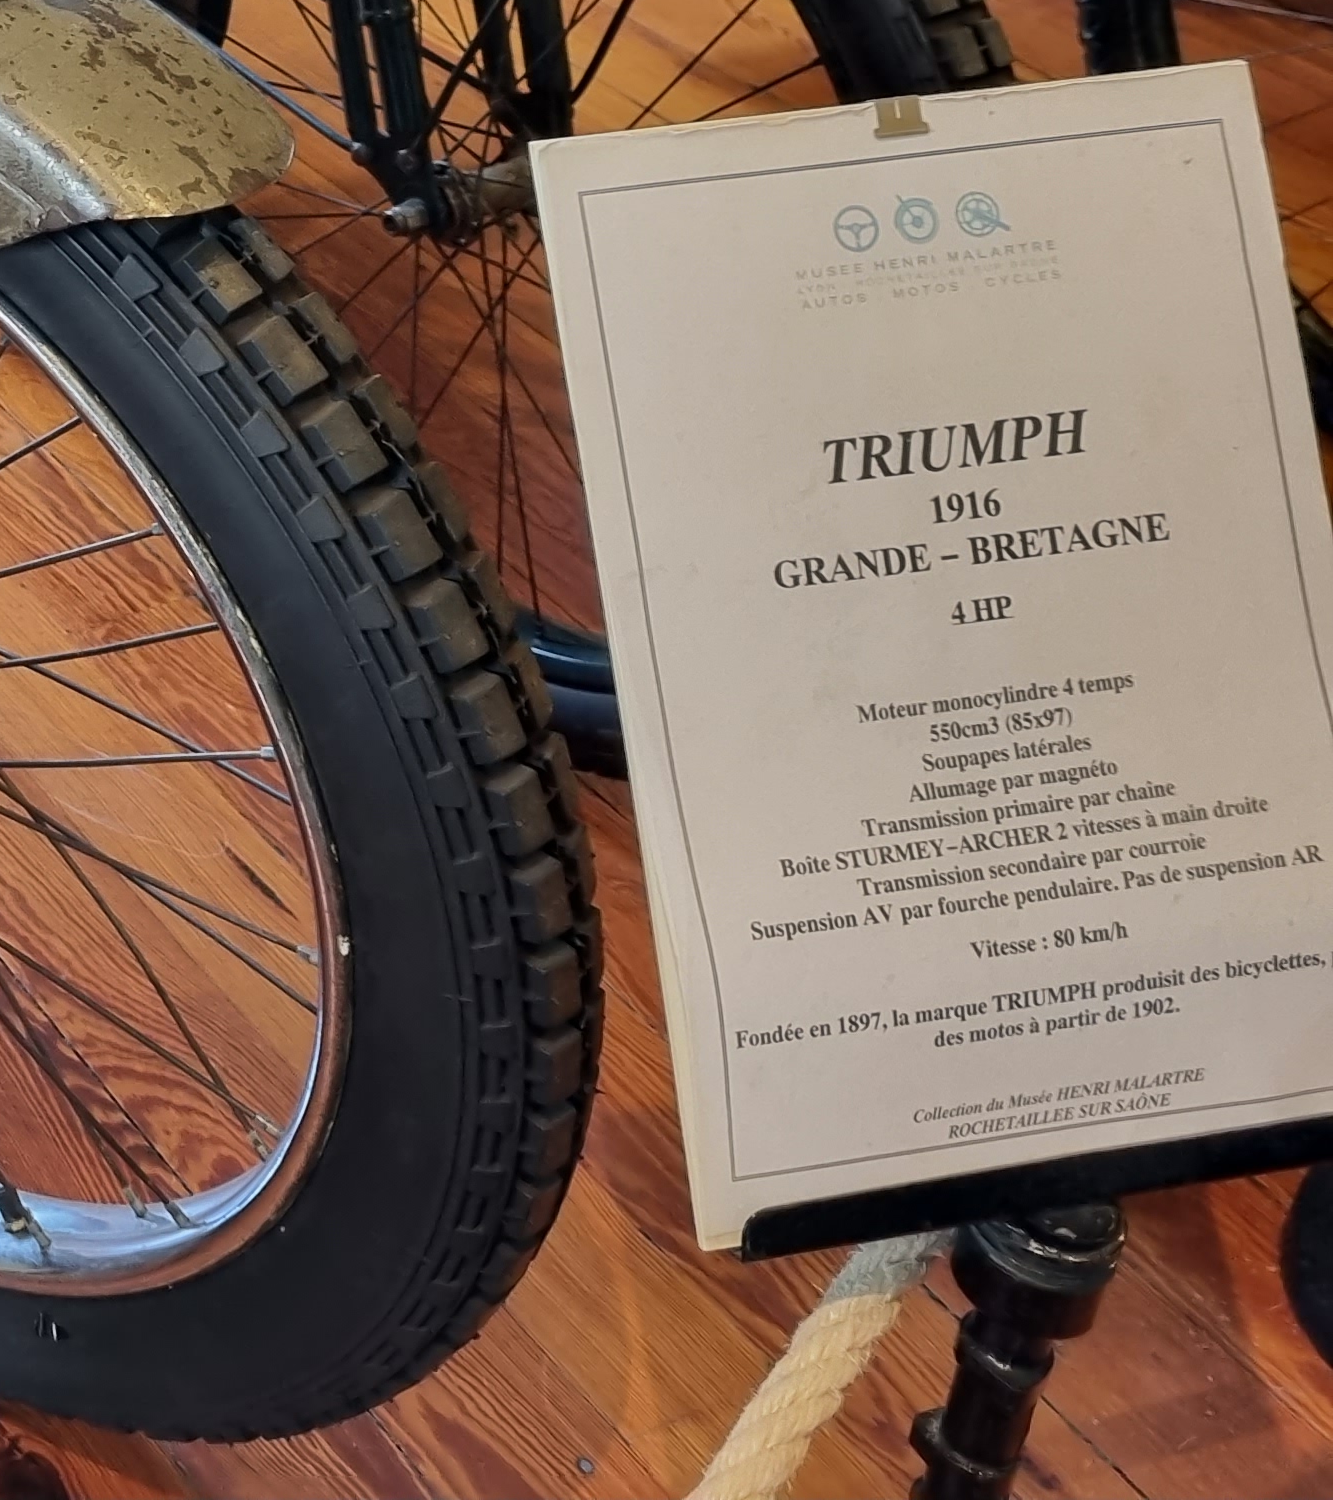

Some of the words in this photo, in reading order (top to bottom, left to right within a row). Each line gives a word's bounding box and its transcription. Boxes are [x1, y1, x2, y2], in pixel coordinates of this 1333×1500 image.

[795, 262, 864, 280] MUSEE
[873, 253, 936, 271] HENRI
[946, 239, 1057, 261] MALARTRE
[802, 292, 867, 310] AUTOS
[893, 281, 959, 299] MOTOS
[984, 269, 1062, 288] CYCLES
[823, 408, 1088, 485] TRIUMPH
[930, 488, 1001, 524] 1916
[774, 543, 932, 589] GRANDE
[966, 513, 1170, 566] BRETAGNE
[950, 602, 967, 625] 4
[972, 595, 1013, 621] HP
[855, 701, 929, 724] Moteur
[931, 682, 1059, 714] monocylindre
[1062, 677, 1075, 696] 4
[1077, 674, 1134, 695] temps
[929, 715, 1000, 743] 550cm3
[1004, 706, 1073, 736] (85x97)
[921, 748, 1011, 773] Soupapes
[1012, 734, 1092, 761] latérales
[909, 778, 998, 803] Allumage
[1000, 773, 1035, 795] par
[1037, 759, 1119, 786] magnéto
[860, 805, 990, 838] Transmission
[991, 793, 1075, 826] primaire
[1077, 790, 1112, 814] par
[1115, 780, 1176, 803] chaîne
[778, 855, 832, 878] Boîte
[1055, 821, 1069, 841] 2
[1071, 816, 1142, 838] vitesses
[1144, 808, 1160, 829] à
[1160, 803, 1210, 826] main
[1212, 796, 1269, 819] droite
[855, 864, 986, 897] Transmission
[987, 850, 1088, 880] secondaire
[1090, 847, 1124, 870] par
[1128, 832, 1207, 860] courroie
[750, 911, 859, 941] Suspension
[863, 903, 893, 926] AV
[899, 903, 934, 926] par
[937, 889, 1010, 916] fourche
[1012, 875, 1120, 911] pendulaire.
[1120, 870, 1157, 890] Pas
[1159, 864, 1183, 884] de
[1185, 852, 1288, 882] suspension
[1291, 844, 1325, 866] AR
[969, 938, 1038, 959] Vitesse
[1052, 927, 1076, 949] 80
[1078, 920, 1130, 945] km/h
[734, 1022, 805, 1050] Fondée
[809, 1023, 832, 1039] en
[837, 1011, 888, 1035] 1897,
[891, 1009, 911, 1028] la
[914, 1001, 988, 1025] marque
[990, 980, 1098, 1013] TRIUMPH
[1101, 968, 1186, 1002] produisit
[1189, 965, 1221, 984] des
[1224, 952, 1327, 980] bicyclettes,
[933, 1029, 965, 1048] des
[968, 1022, 1025, 1043] motos
[1029, 1016, 1041, 1035] à
[1045, 1008, 1102, 1036] partir
[1104, 1005, 1128, 1023] de
[1132, 996, 1181, 1019] 1902.
[912, 1102, 983, 1124] Collection
[985, 1097, 1005, 1113] du
[1007, 1089, 1054, 1108] Musée
[1056, 1080, 1111, 1102] HENRI
[1113, 1067, 1206, 1094] MALARTRE
[948, 1106, 1074, 1139] ROCHETAILLEE
[1078, 1102, 1112, 1119] SUR
[1114, 1092, 1171, 1113] SAÔNE
